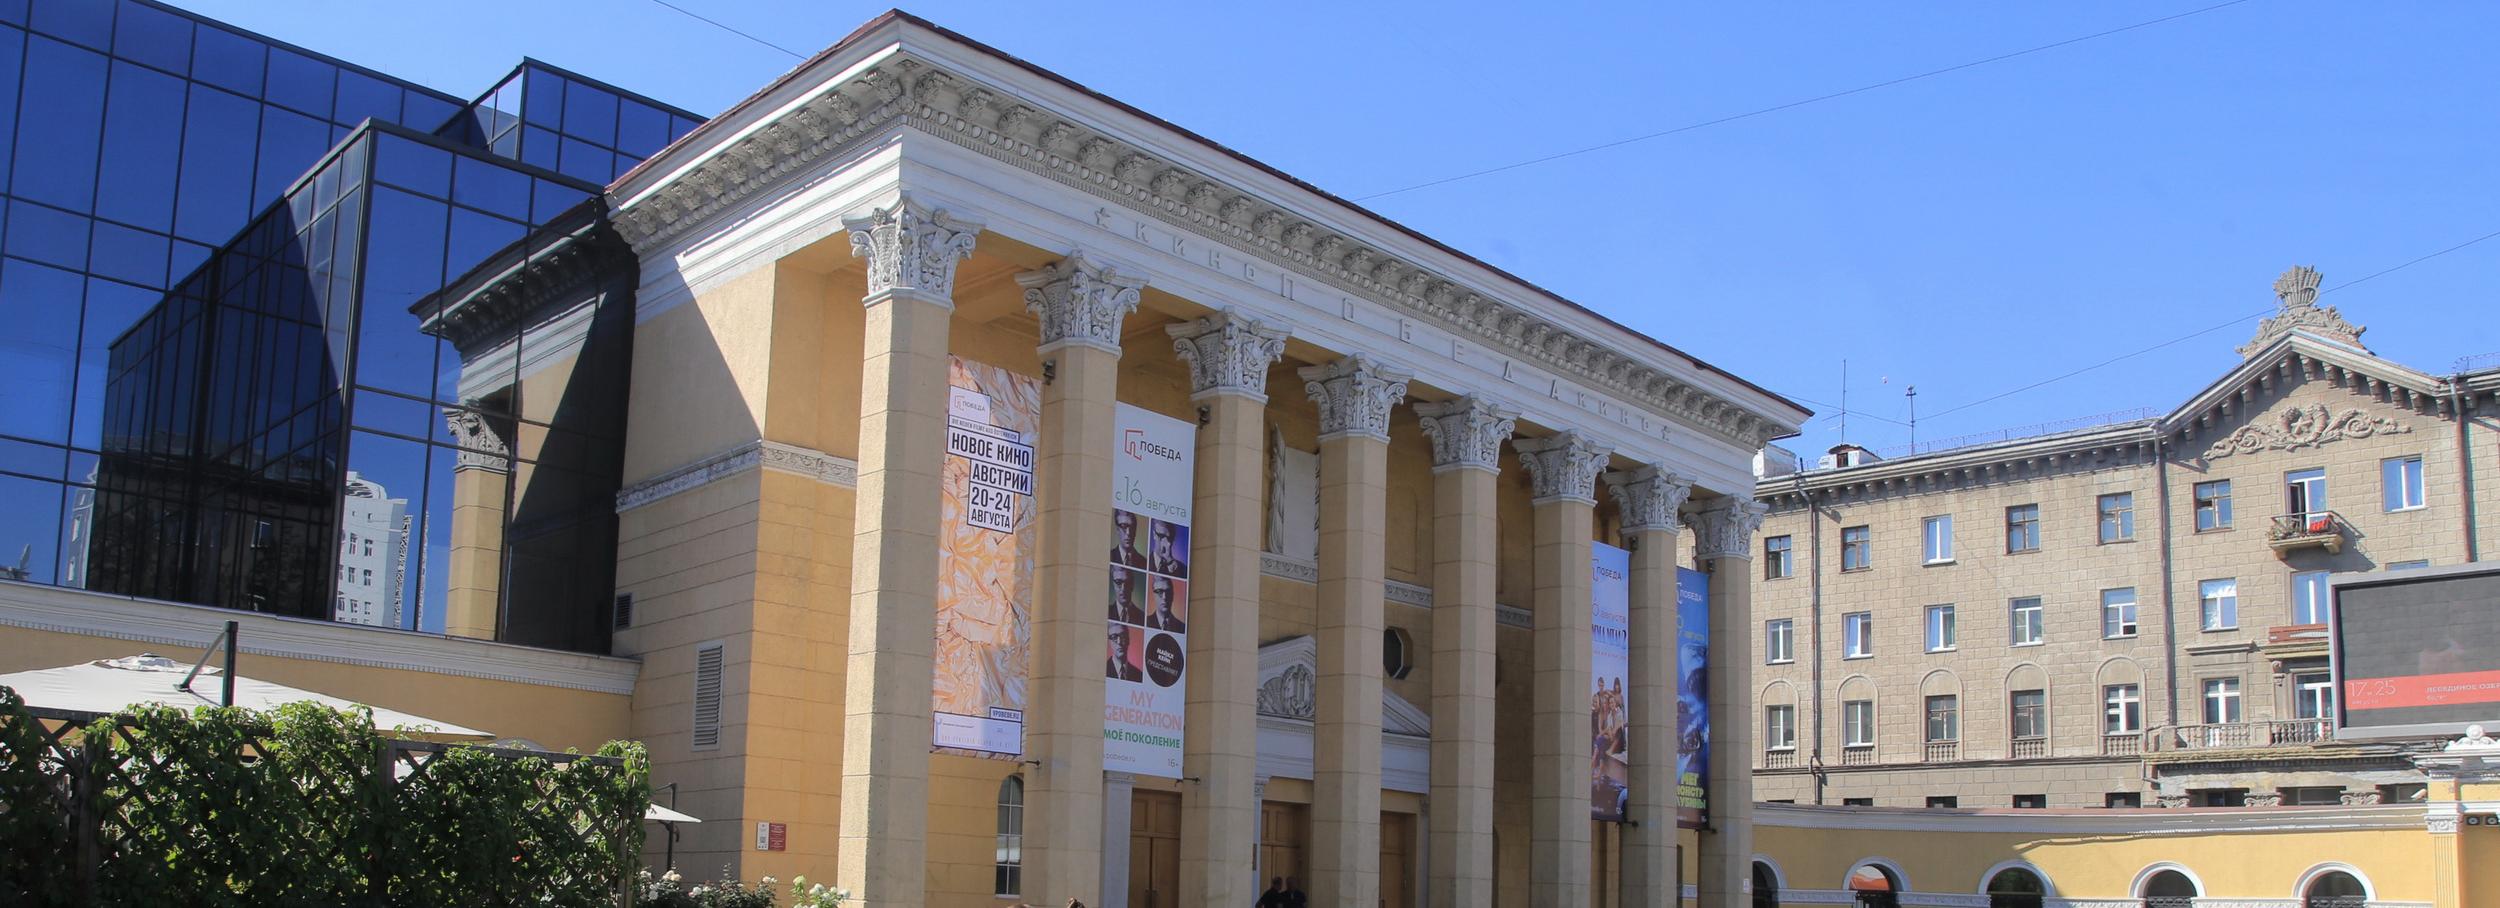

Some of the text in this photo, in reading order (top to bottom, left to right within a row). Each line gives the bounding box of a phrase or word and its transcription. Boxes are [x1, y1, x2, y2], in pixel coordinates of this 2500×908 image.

[1135, 221, 1256, 281] КИНО
[1281, 273, 1561, 401] ПОБЕДА
[952, 432, 1030, 467] НОВОЕ КИНО
[1140, 440, 1182, 461] ПОБЕДА
[972, 463, 1028, 492] АВСТРИИ
[971, 486, 1011, 513] 20-24
[1124, 476, 1143, 506] 16
[1146, 499, 1187, 518] августа
[971, 508, 1011, 529] АВГУСТА
[1597, 566, 1622, 580] ПОБЕДА
[1130, 688, 1155, 709] MY
[1104, 703, 1183, 731] GENERATION
[1104, 728, 1181, 749] МОЁ ПОКОЛЕНИЕ
